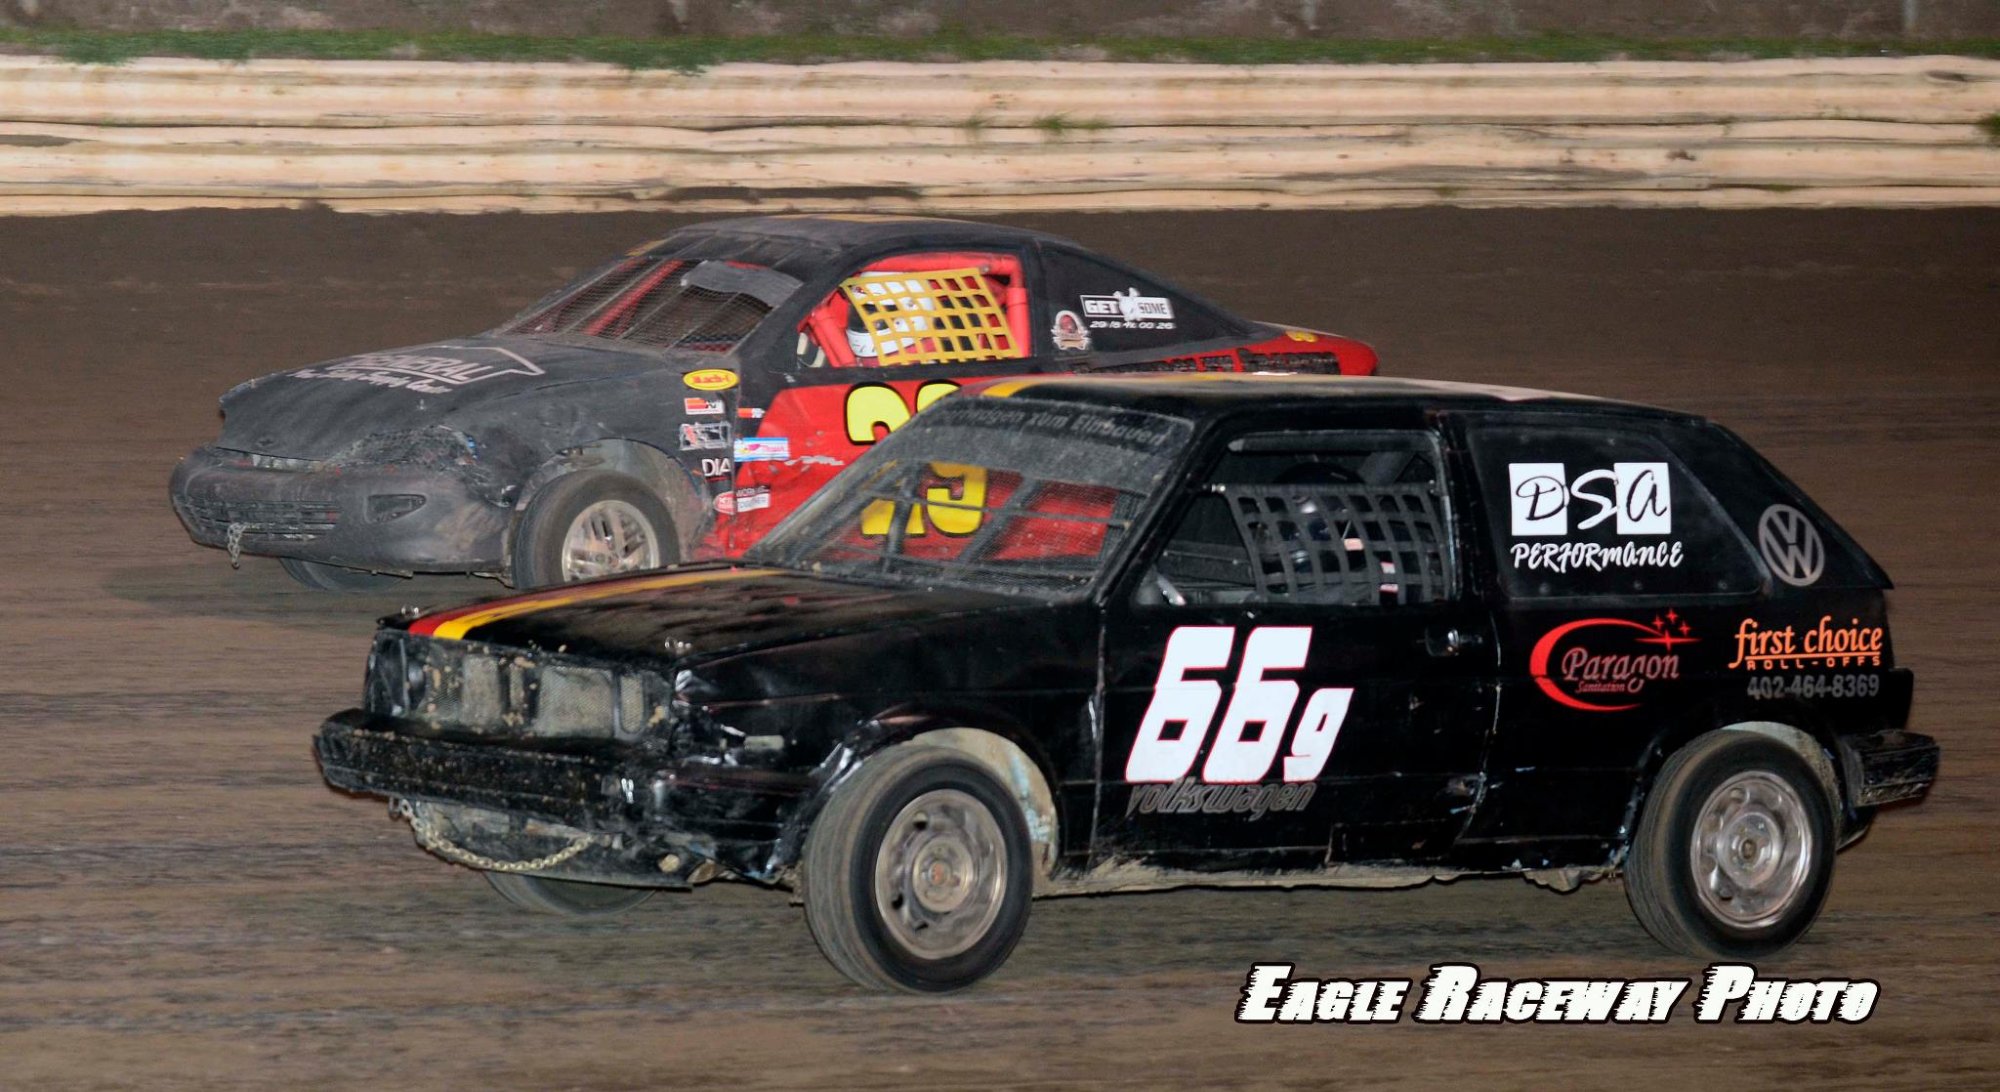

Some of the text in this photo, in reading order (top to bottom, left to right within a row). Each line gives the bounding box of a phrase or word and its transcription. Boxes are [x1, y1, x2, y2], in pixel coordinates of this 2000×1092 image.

[1085, 299, 1168, 315] GET SOME
[1728, 616, 1883, 668] first choice
[1562, 647, 1681, 694] Paragon
[1747, 656, 1881, 670] ROLL-OFFS
[1747, 674, 1880, 699] 402-464-8369
